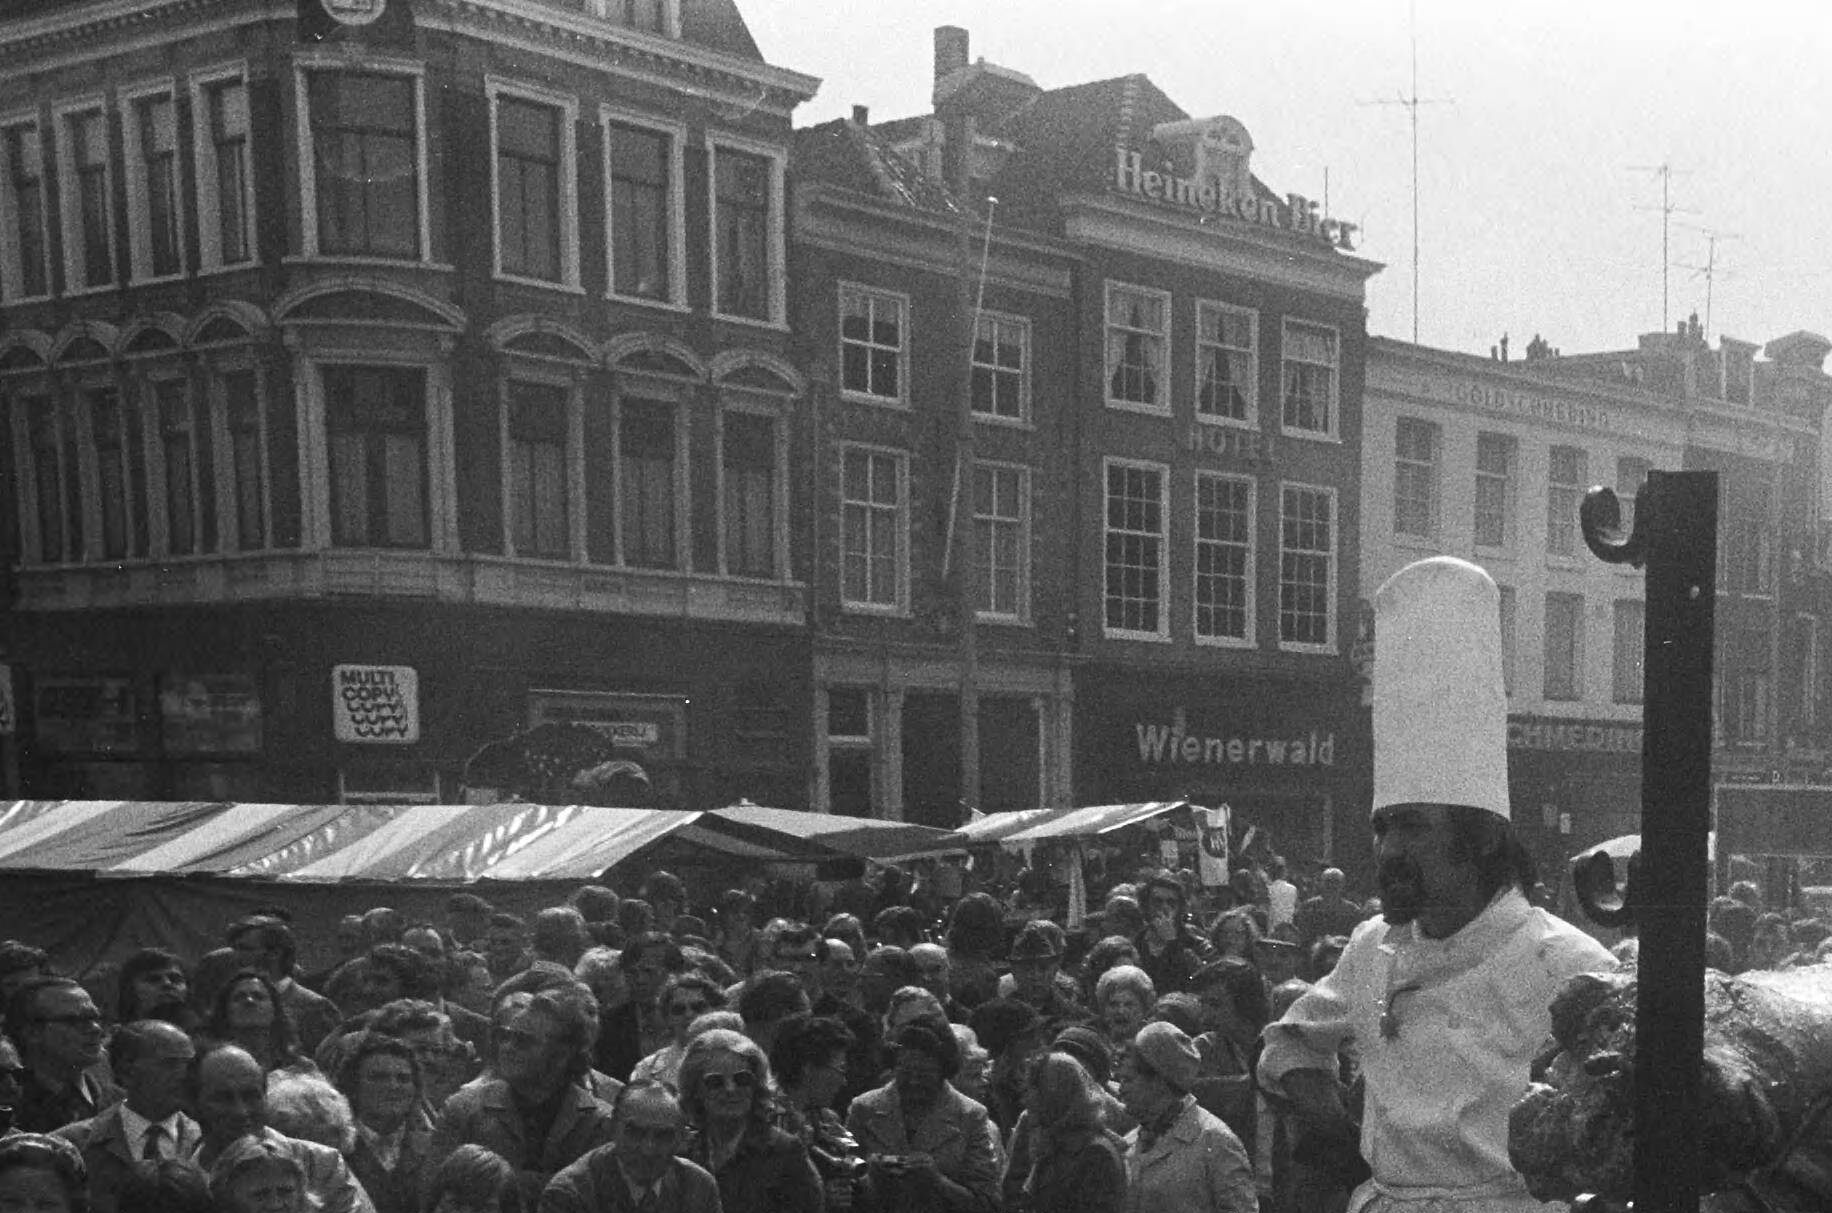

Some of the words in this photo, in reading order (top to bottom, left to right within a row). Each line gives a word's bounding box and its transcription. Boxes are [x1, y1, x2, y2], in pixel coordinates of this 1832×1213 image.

[1116, 149, 1281, 229] Heineken
[1286, 192, 1358, 252] Bier
[340, 671, 394, 686] MULTI
[342, 684, 402, 701] COPY
[1136, 722, 1335, 766] Wienerwald
